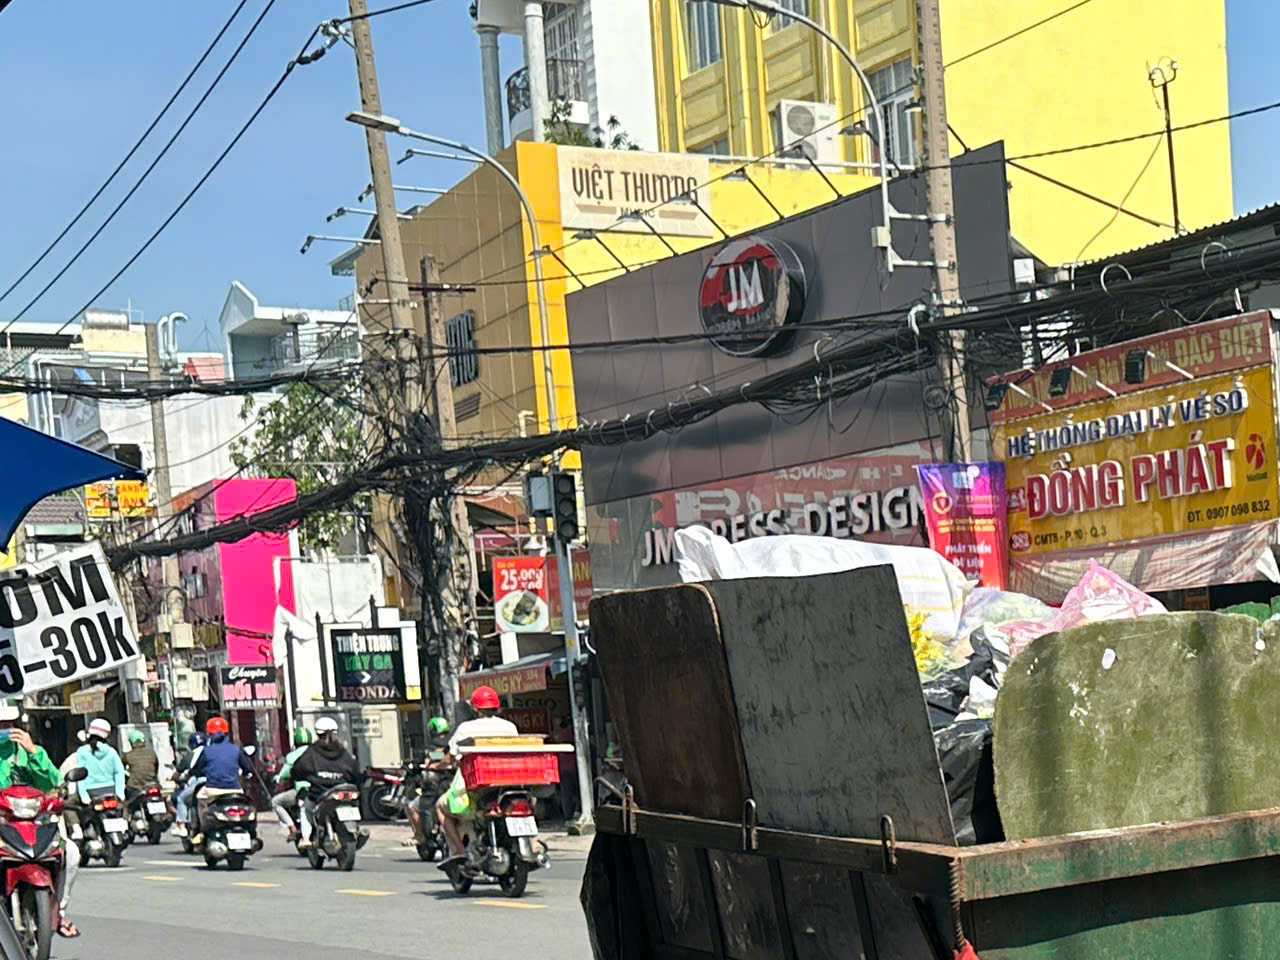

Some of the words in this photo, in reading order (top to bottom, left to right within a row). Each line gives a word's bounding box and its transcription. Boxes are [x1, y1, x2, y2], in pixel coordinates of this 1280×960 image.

[572, 163, 614, 205] VIỆT
[727, 259, 765, 313] JM
[1174, 326, 1215, 373] ĐẶC
[1218, 318, 1265, 363] BIỆT
[1008, 426, 1036, 460] HỆ
[1036, 413, 1107, 450] THỐNG
[1148, 395, 1175, 429] LÝ
[1213, 374, 1250, 415] SỐ
[1025, 451, 1124, 521] ĐỒNG
[1131, 430, 1236, 503] PHÁT
[1206, 506, 1230, 521] 0907
[1232, 504, 1250, 517] 098
[1251, 499, 1271, 513] 832
[341, 684, 401, 700] HONDA
